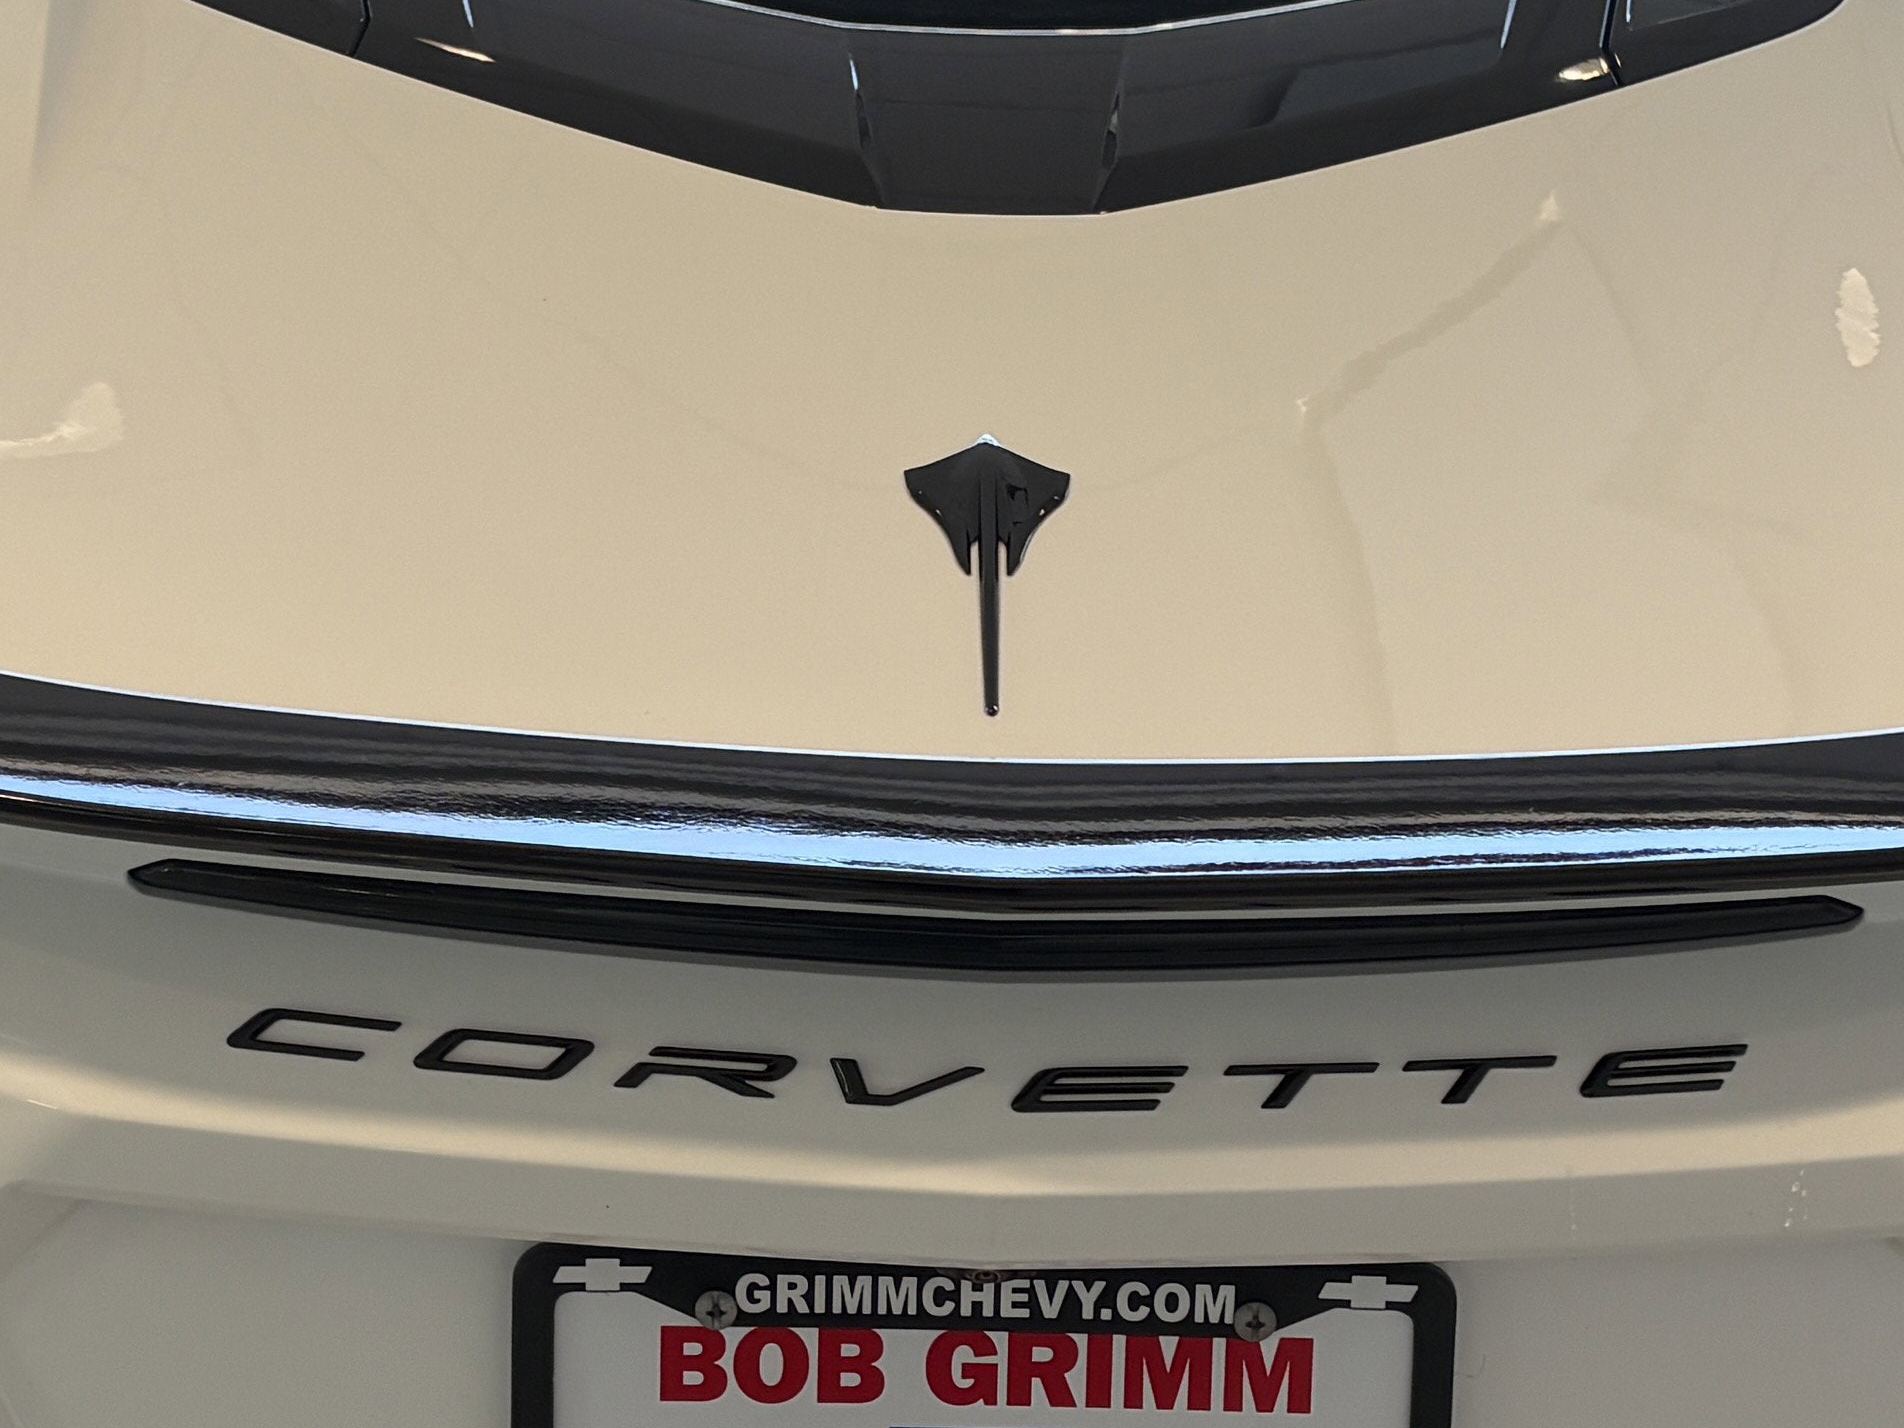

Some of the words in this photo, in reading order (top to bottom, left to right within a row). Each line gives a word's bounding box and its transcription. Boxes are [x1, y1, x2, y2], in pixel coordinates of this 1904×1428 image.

[225, 1006, 1749, 1114] CORVETTE
[734, 1272, 1237, 1325] GRIMMCHEVY.COM
[659, 1325, 886, 1405] BOB
[924, 1331, 1315, 1415] GRIMM
